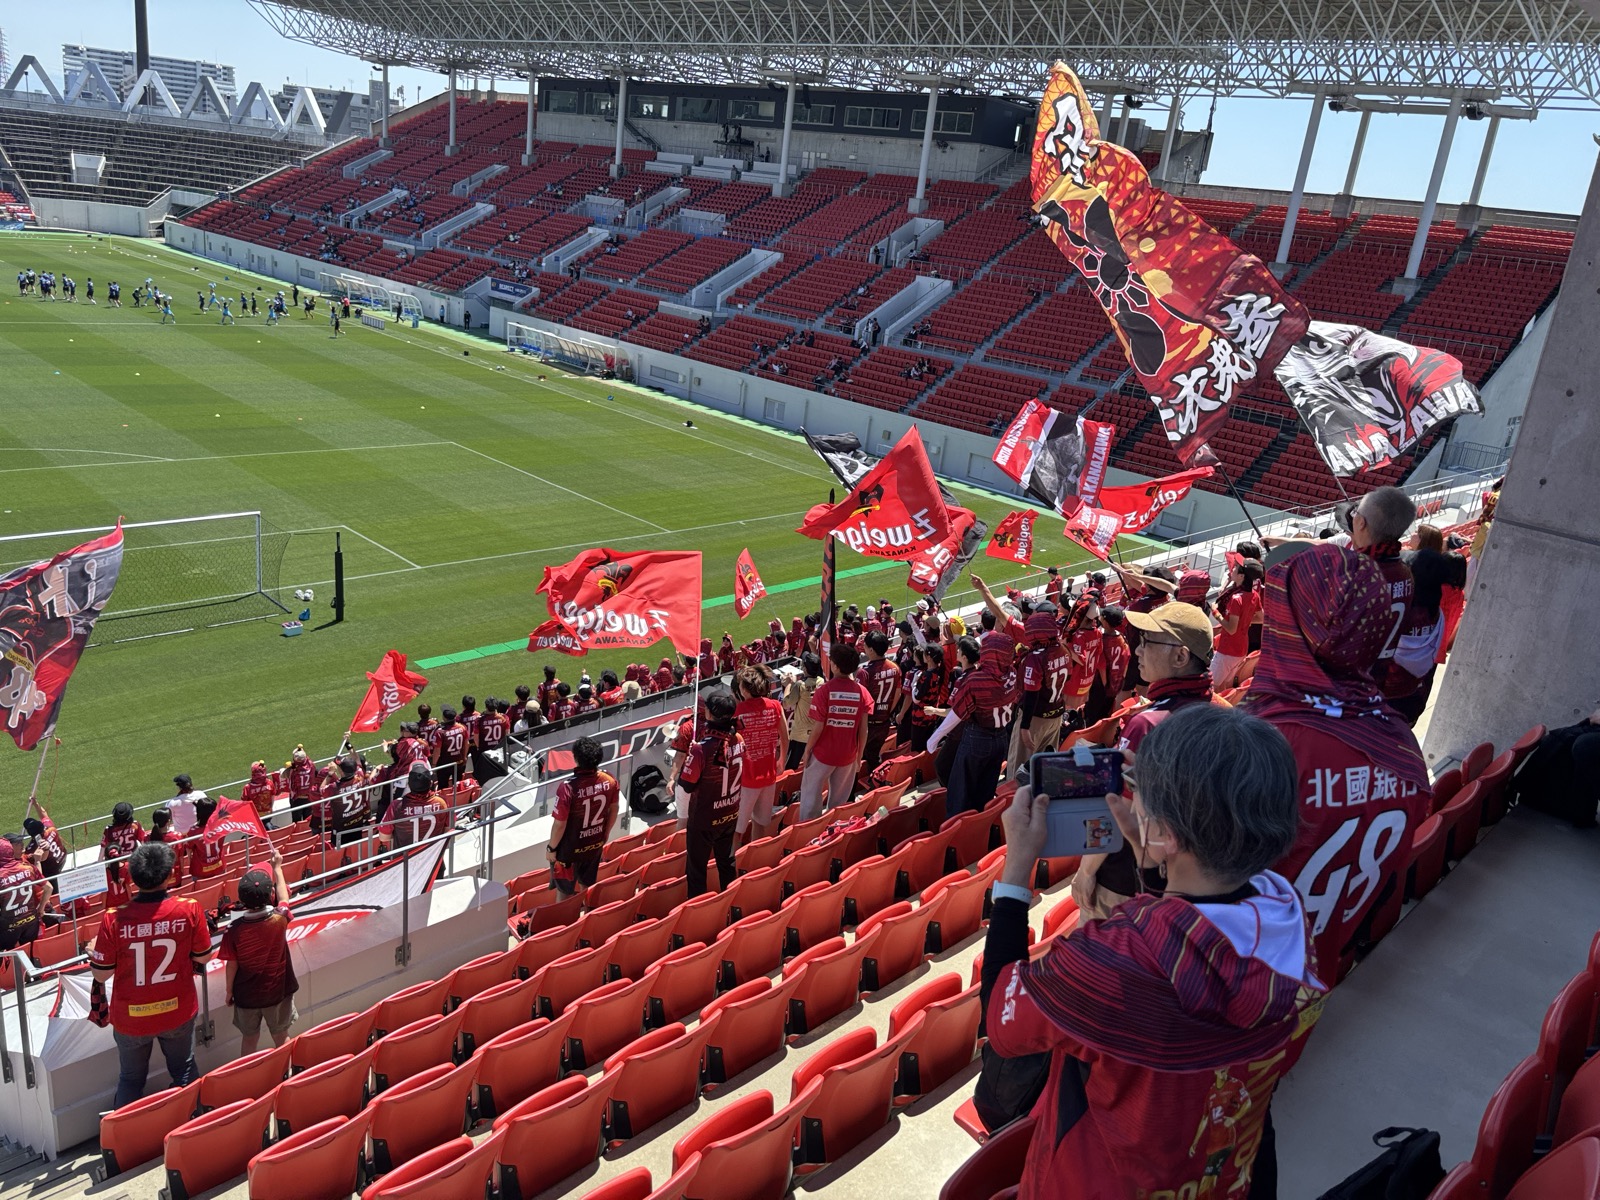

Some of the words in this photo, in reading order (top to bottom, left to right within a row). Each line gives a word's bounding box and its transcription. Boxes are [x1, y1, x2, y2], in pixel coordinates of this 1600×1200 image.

[1083, 427, 1112, 493] KANAZAWA
[876, 678, 894, 704] 17
[447, 734, 463, 752] 20
[484, 725, 502, 742] 20
[718, 757, 743, 797] 12
[1305, 766, 1418, 808] 北國銀行
[582, 794, 607, 829] 12
[409, 815, 437, 844] 12
[579, 826, 603, 839] ZWEIGEN
[1293, 809, 1407, 937] 48
[5, 880, 33, 911] 29
[120, 918, 186, 939] 北國銀行
[128, 938, 178, 986] 12
